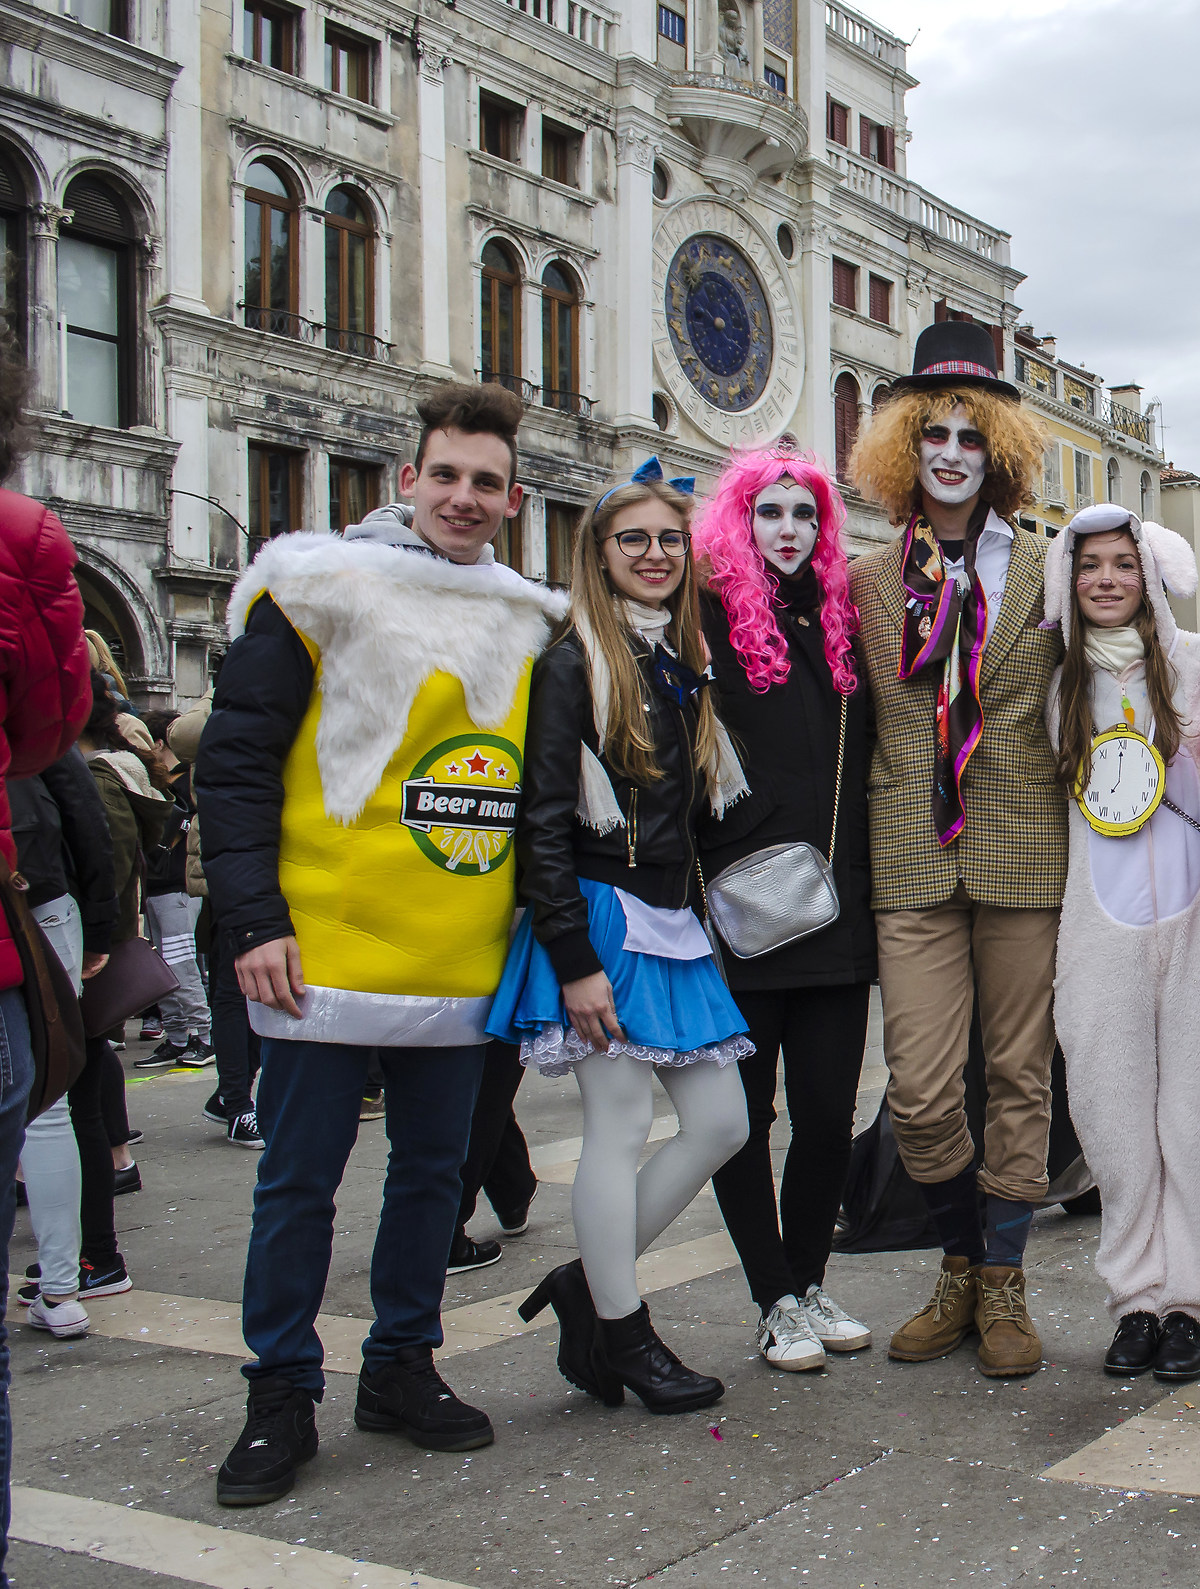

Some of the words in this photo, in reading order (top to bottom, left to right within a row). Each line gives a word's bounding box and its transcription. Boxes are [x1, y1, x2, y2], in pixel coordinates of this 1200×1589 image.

[1117, 739, 1128, 750] XII
[1099, 748, 1108, 760] XI
[1145, 762, 1150, 772] II
[1148, 778, 1156, 788] III
[1087, 791, 1100, 802] VIII
[1141, 792, 1149, 803] IV
[416, 791, 476, 815] Beer
[477, 800, 516, 819] man
[1131, 805, 1138, 815] V
[1098, 806, 1108, 817] VII
[1113, 811, 1121, 822] VI
